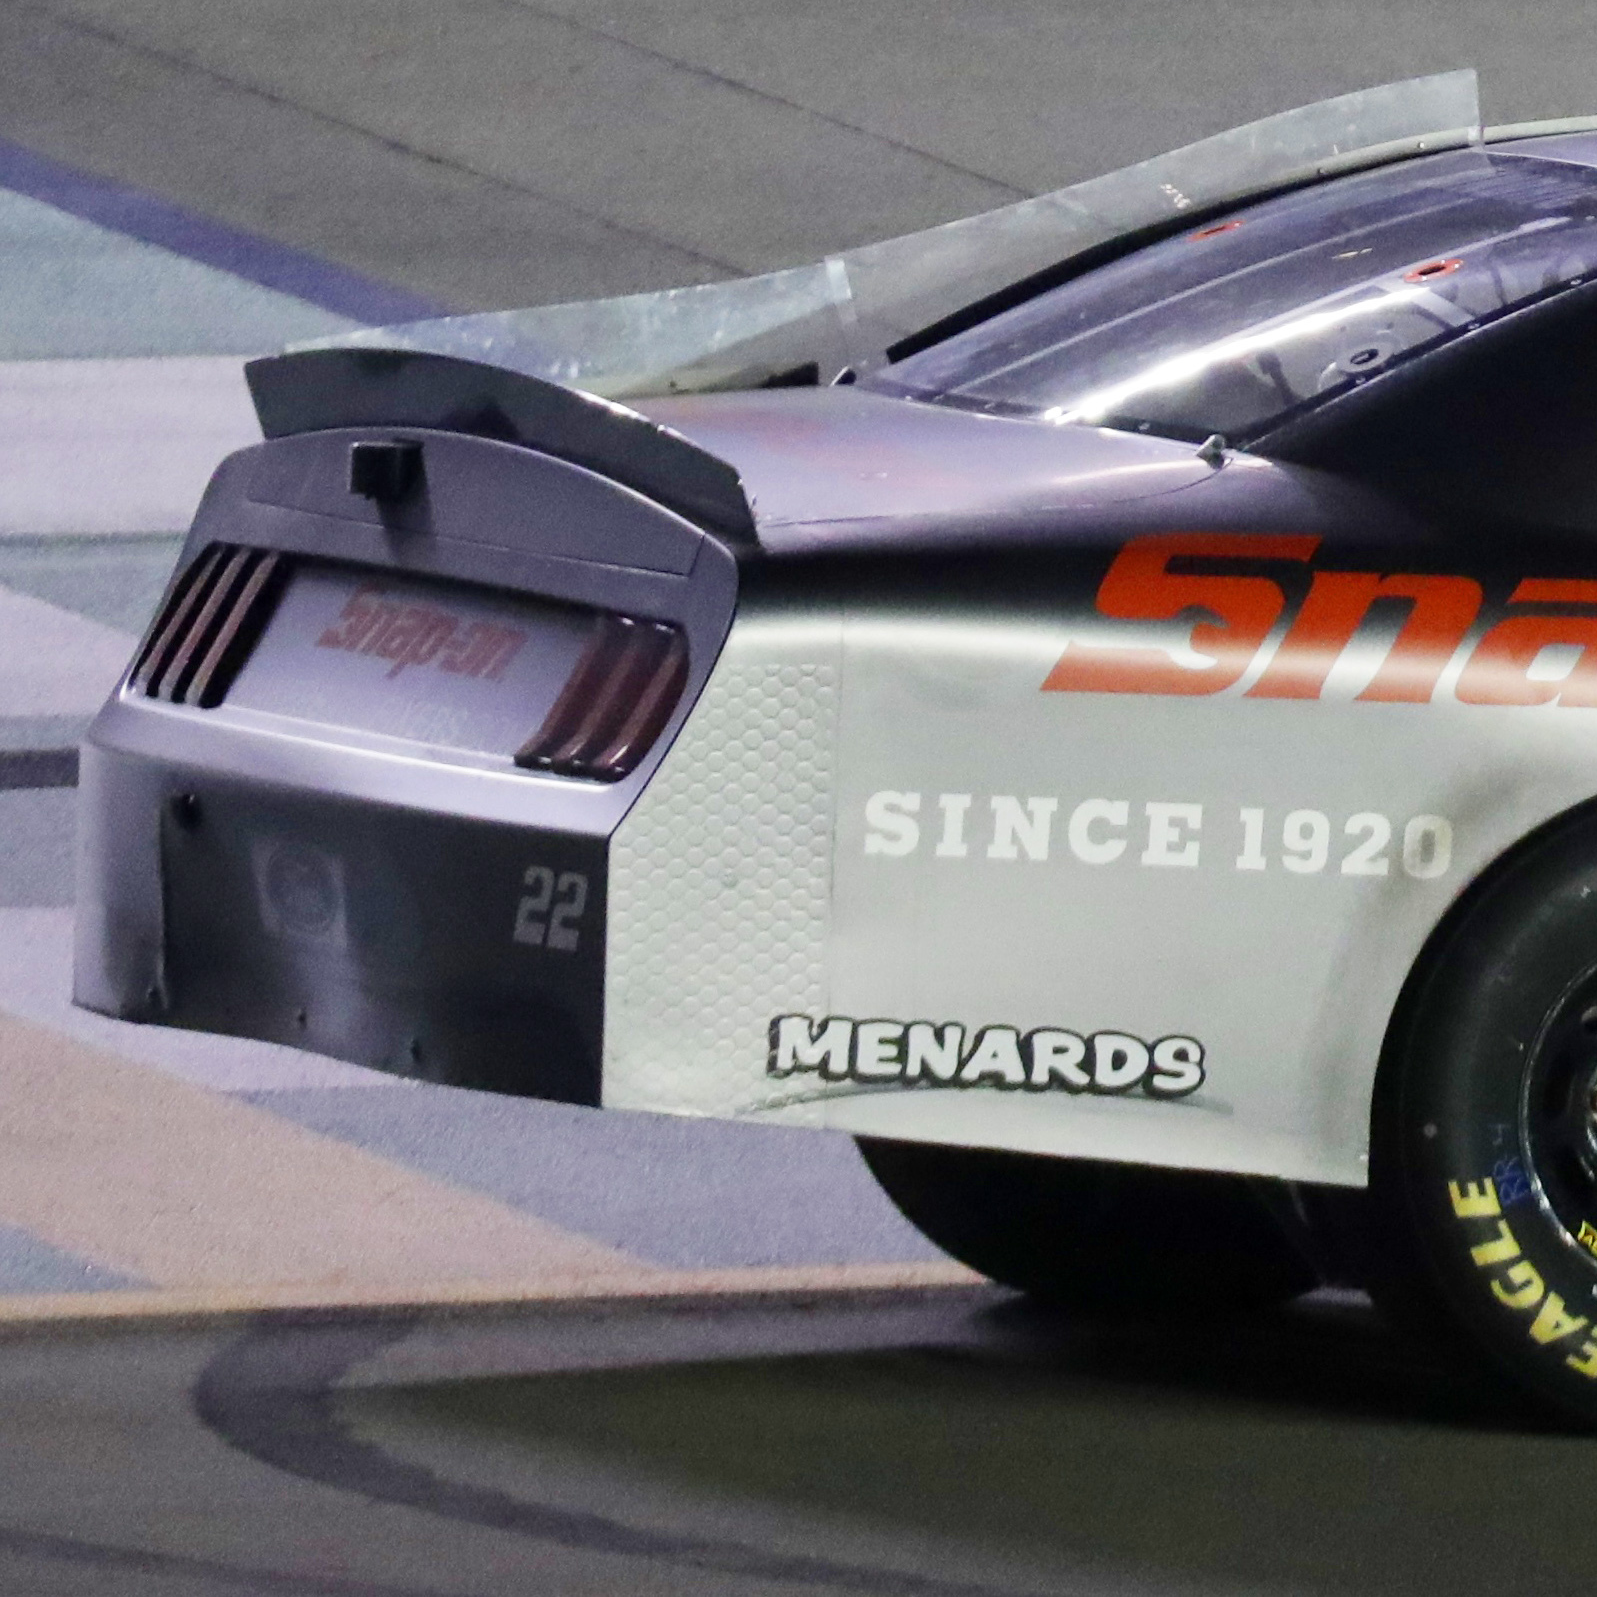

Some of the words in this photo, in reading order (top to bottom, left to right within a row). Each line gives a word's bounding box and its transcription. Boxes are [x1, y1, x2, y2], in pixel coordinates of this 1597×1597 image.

[864, 791, 1203, 868] SINCE
[1236, 807, 1453, 879] 1920
[512, 864, 588, 952] 22
[766, 1014, 1206, 1099] MENARDS
